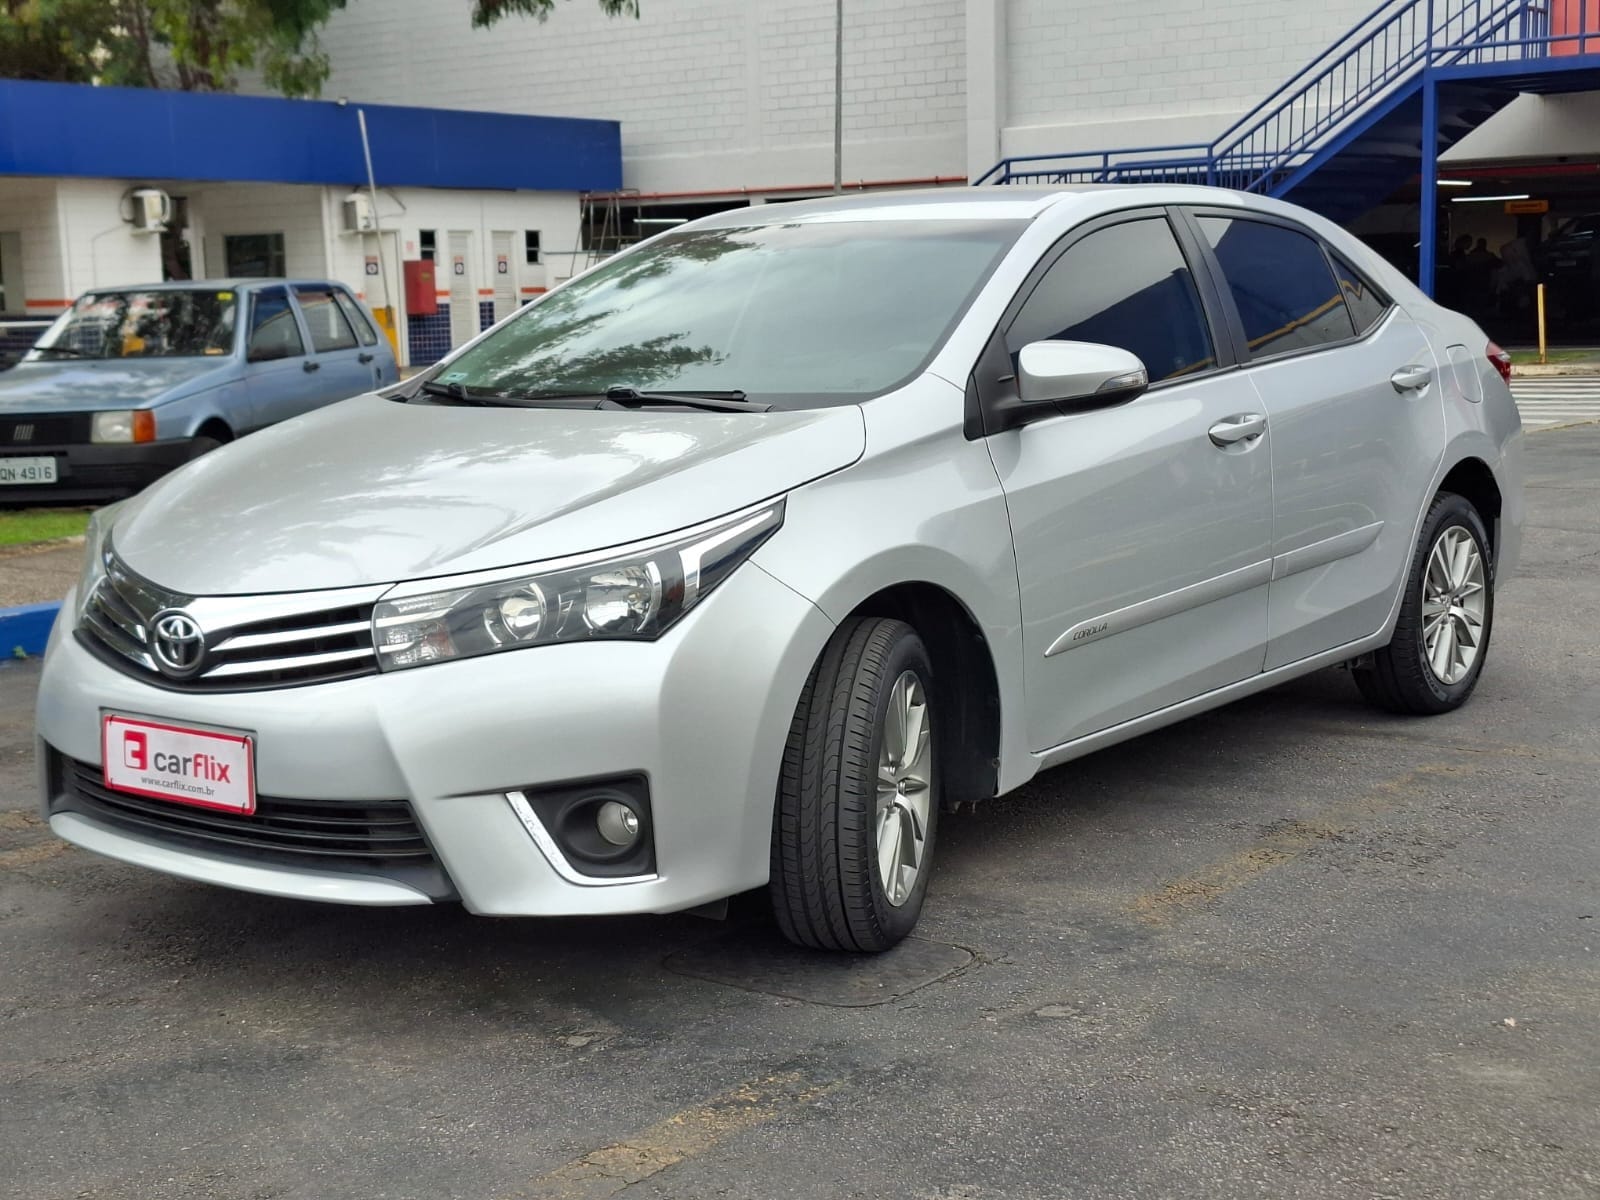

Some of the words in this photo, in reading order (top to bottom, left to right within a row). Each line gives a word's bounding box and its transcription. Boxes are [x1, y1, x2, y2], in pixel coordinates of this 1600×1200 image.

[1072, 622, 1108, 640] COROLLA
[154, 752, 230, 783] carflix
[141, 776, 215, 796] www.carflix.com.br
